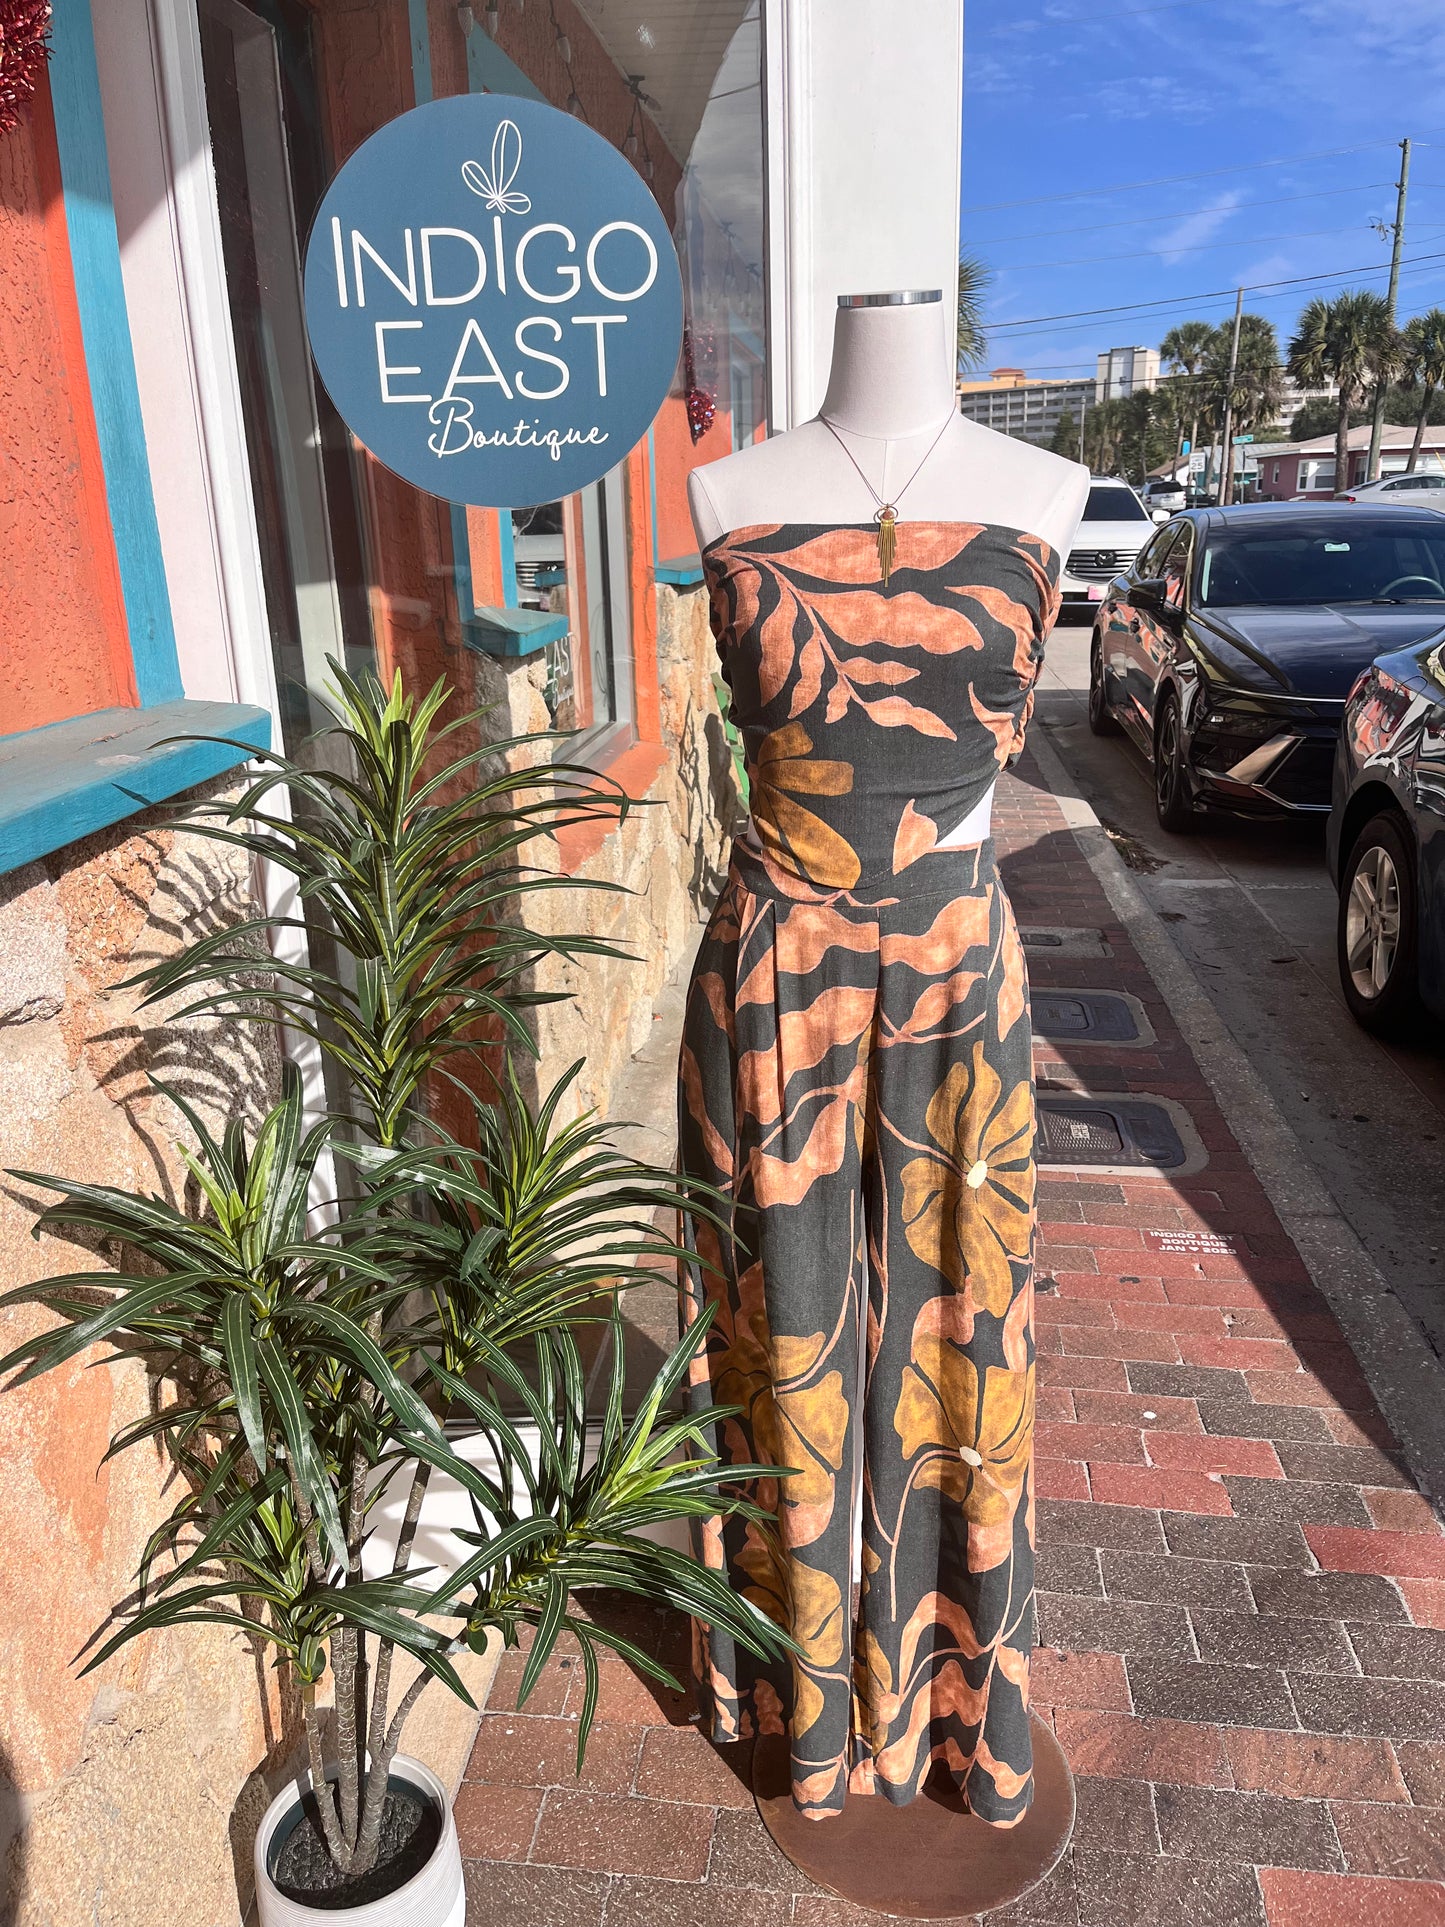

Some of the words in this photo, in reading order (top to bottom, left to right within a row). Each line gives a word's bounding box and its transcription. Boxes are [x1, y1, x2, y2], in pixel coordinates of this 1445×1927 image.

[331, 216, 659, 308] INDIGO
[375, 315, 628, 403] EAST
[428, 396, 609, 461] Boutique
[1159, 1244, 1186, 1252] JAN
[1202, 1247, 1237, 1255] 2023
[1161, 1238, 1229, 1247] BOUTIQUE
[1200, 1233, 1234, 1241] EAST
